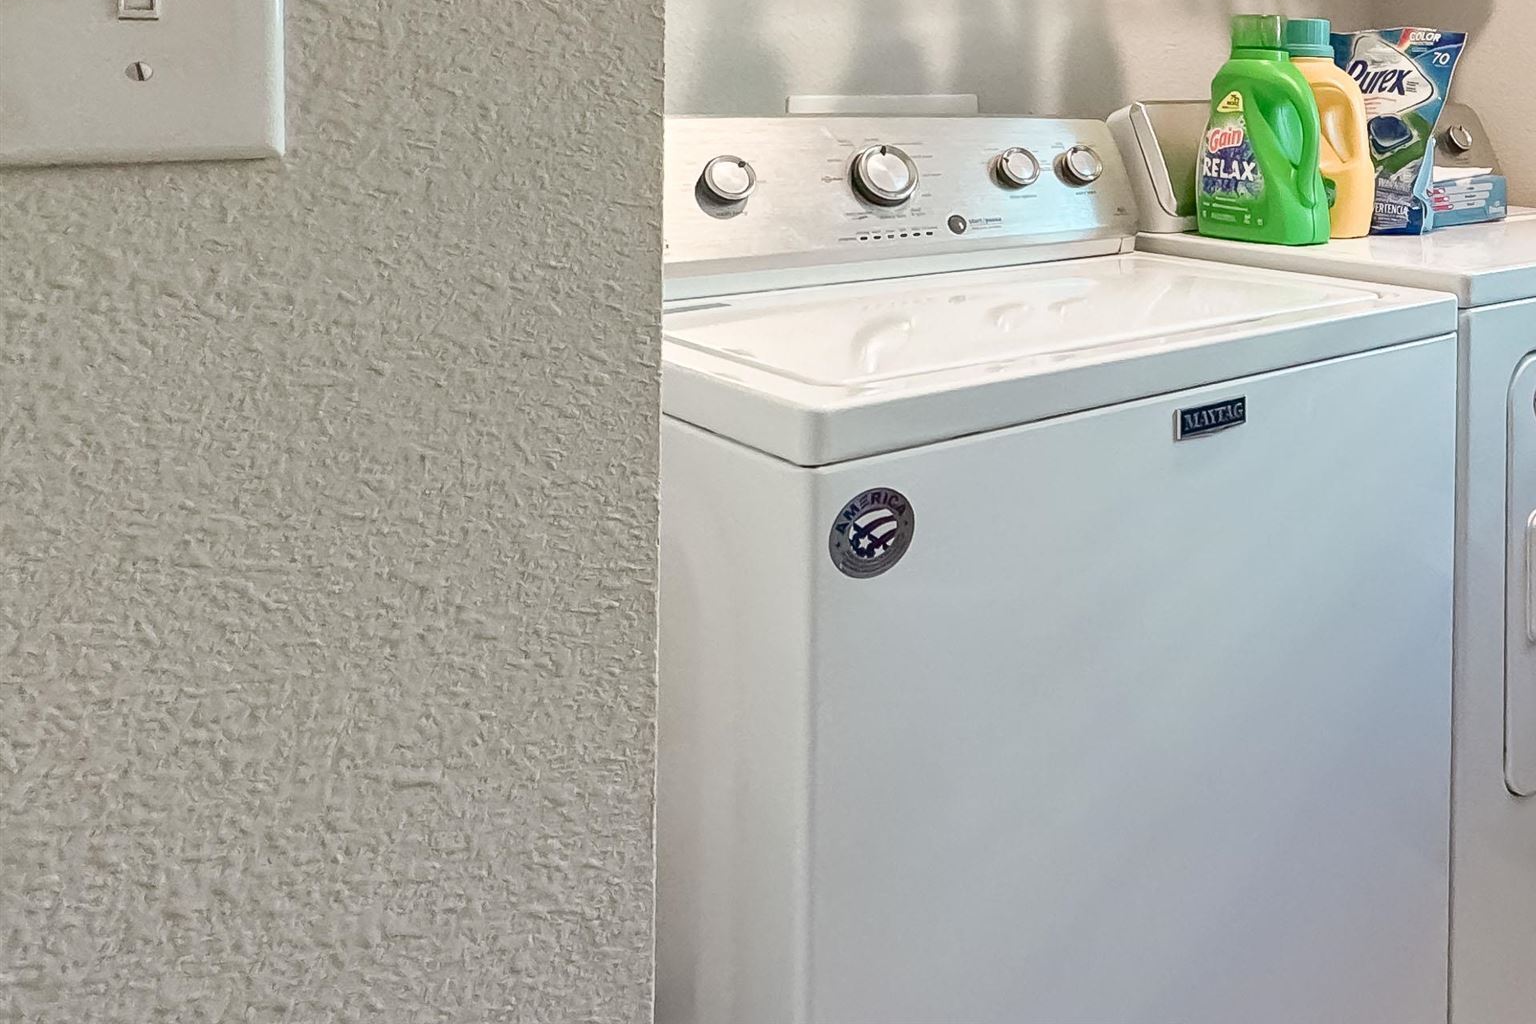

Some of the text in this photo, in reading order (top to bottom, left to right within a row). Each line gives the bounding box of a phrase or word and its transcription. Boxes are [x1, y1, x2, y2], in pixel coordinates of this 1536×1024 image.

[1409, 31, 1441, 42] COLOR
[1432, 51, 1450, 65] 70
[1347, 59, 1413, 95] Purex
[1209, 127, 1244, 151] Gain
[1203, 157, 1256, 181] RELAX
[1374, 203, 1409, 216] ERTENCIA
[1184, 402, 1244, 431] MAYTAG
[835, 491, 906, 534] AMERICA
